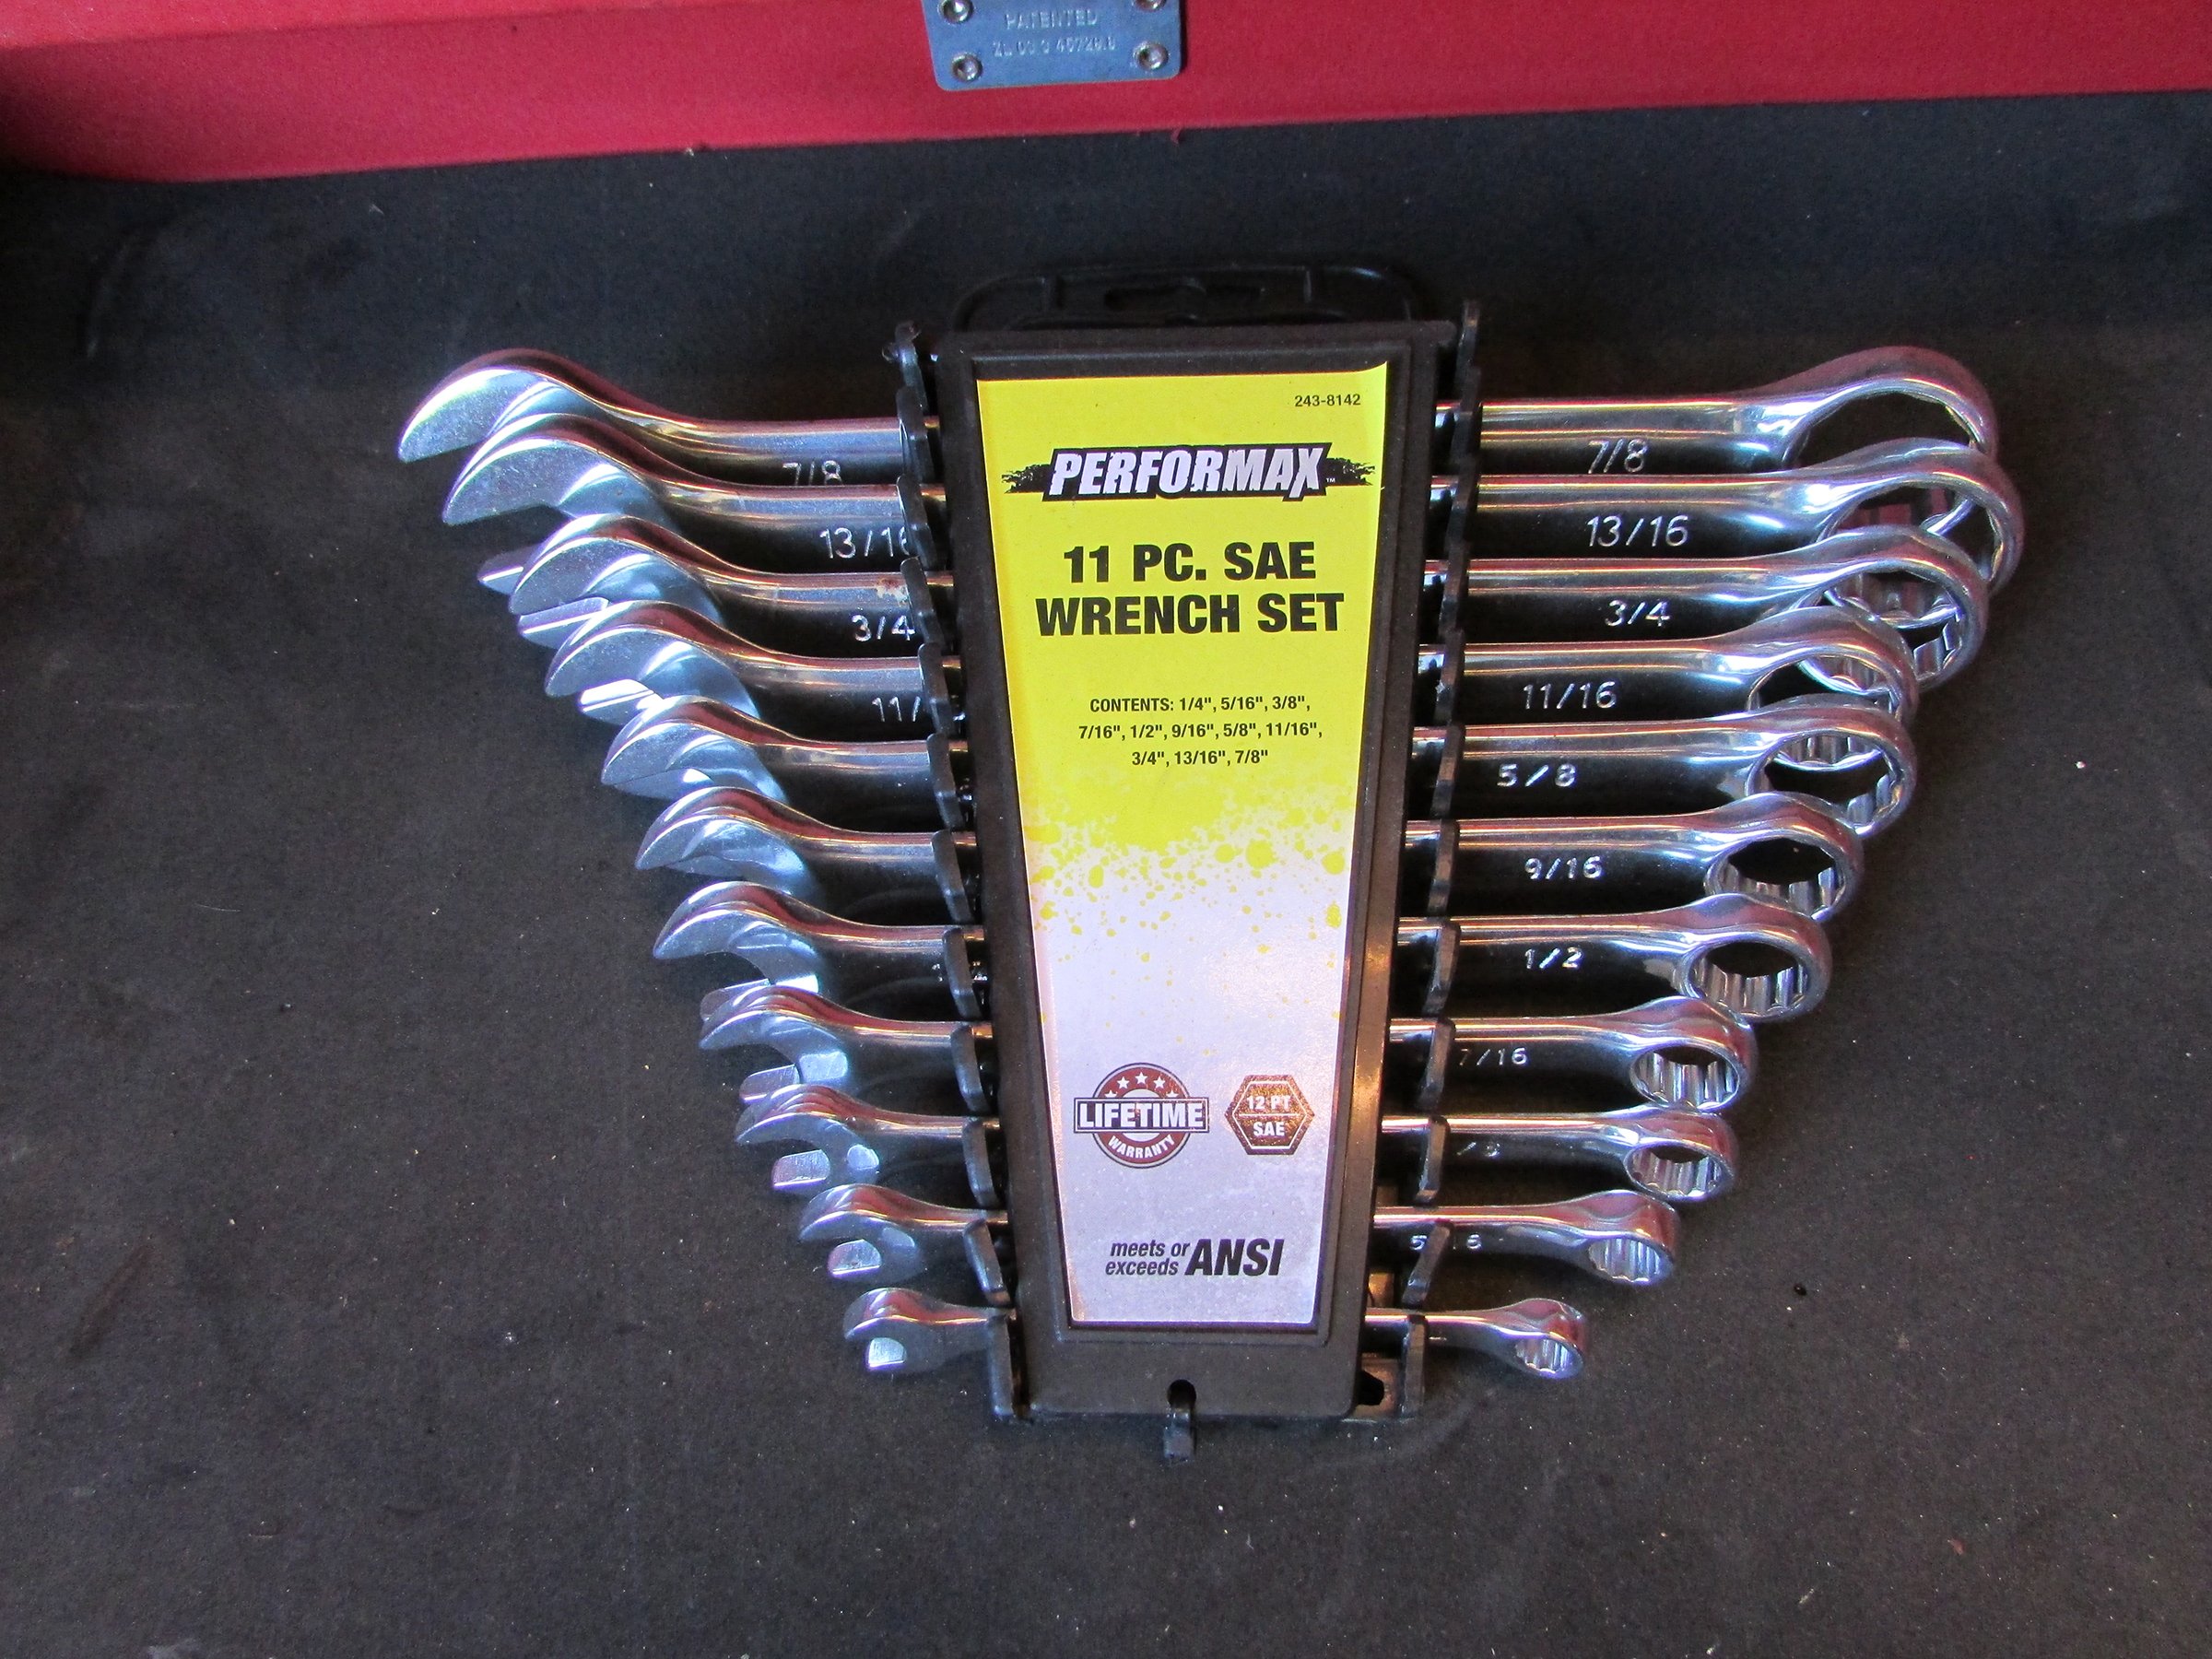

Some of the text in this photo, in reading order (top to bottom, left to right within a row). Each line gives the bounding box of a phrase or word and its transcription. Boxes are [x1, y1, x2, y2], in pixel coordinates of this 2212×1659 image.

[1005, 9, 1098, 30] PATENTED
[1294, 394, 1361, 407] 243-8142
[1588, 438, 1650, 474] 7/8
[1048, 446, 1325, 499] PERFORMAX
[1585, 514, 1689, 547] 13/16
[1064, 541, 1316, 583] 11 PC. SAE
[1035, 593, 1345, 637] WRENCH SET
[1605, 599, 1672, 628] 3/4
[851, 615, 915, 641] 3/4
[1089, 695, 1311, 713] CONTENTS: 1/4", 5/16", 3/8",
[1523, 681, 1618, 710] 11/16
[1078, 722, 1323, 741] 7/16", 1/2", 9/16", 5/8", 11/16",
[1131, 749, 1269, 768] 3/4", 13/16", 7/8"
[1497, 763, 1578, 787] 5/8
[1524, 855, 1603, 879] 9/16
[1524, 947, 1584, 969] 1/2
[1459, 1047, 1528, 1065] 7/16
[1247, 1094, 1291, 1110] 12 PT
[1079, 1102, 1204, 1128] LIFETIME
[1253, 1122, 1287, 1137] SAE
[1107, 1134, 1176, 1159] WARRANTY
[1110, 1241, 1191, 1257] meets or
[1184, 1238, 1286, 1277] ANSI
[1105, 1258, 1180, 1276] exceeds
